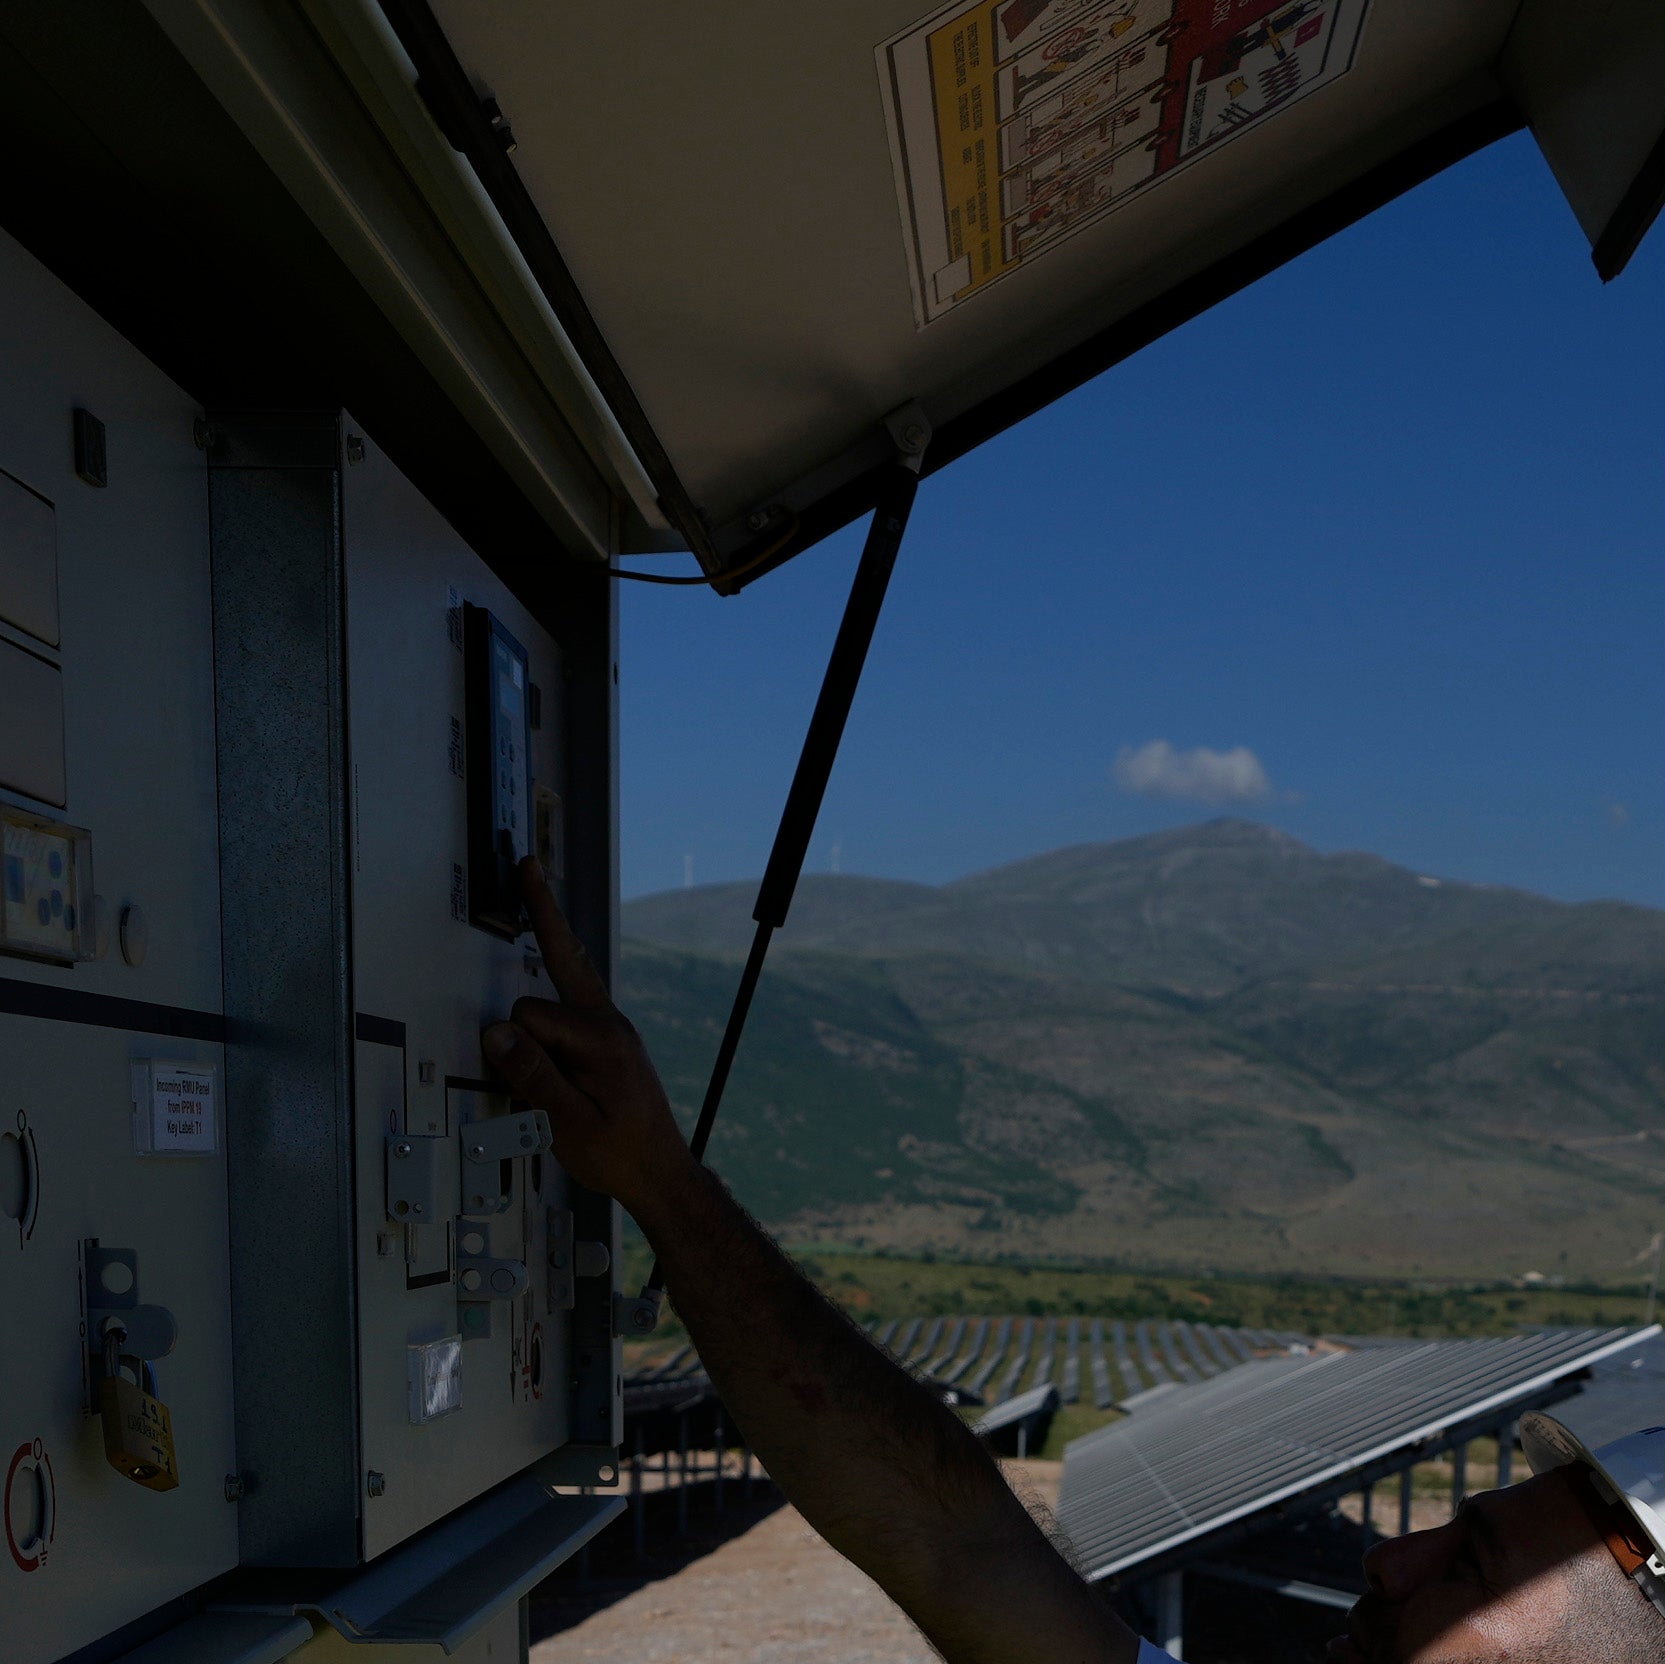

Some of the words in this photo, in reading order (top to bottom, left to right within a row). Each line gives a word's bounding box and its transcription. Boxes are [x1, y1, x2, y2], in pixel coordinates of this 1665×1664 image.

[156, 1077, 181, 1097] Incoming
[182, 1080, 195, 1094] RMU
[196, 1081, 209, 1095] Panel
[167, 1099, 180, 1114] from
[167, 1119, 178, 1138] Key
